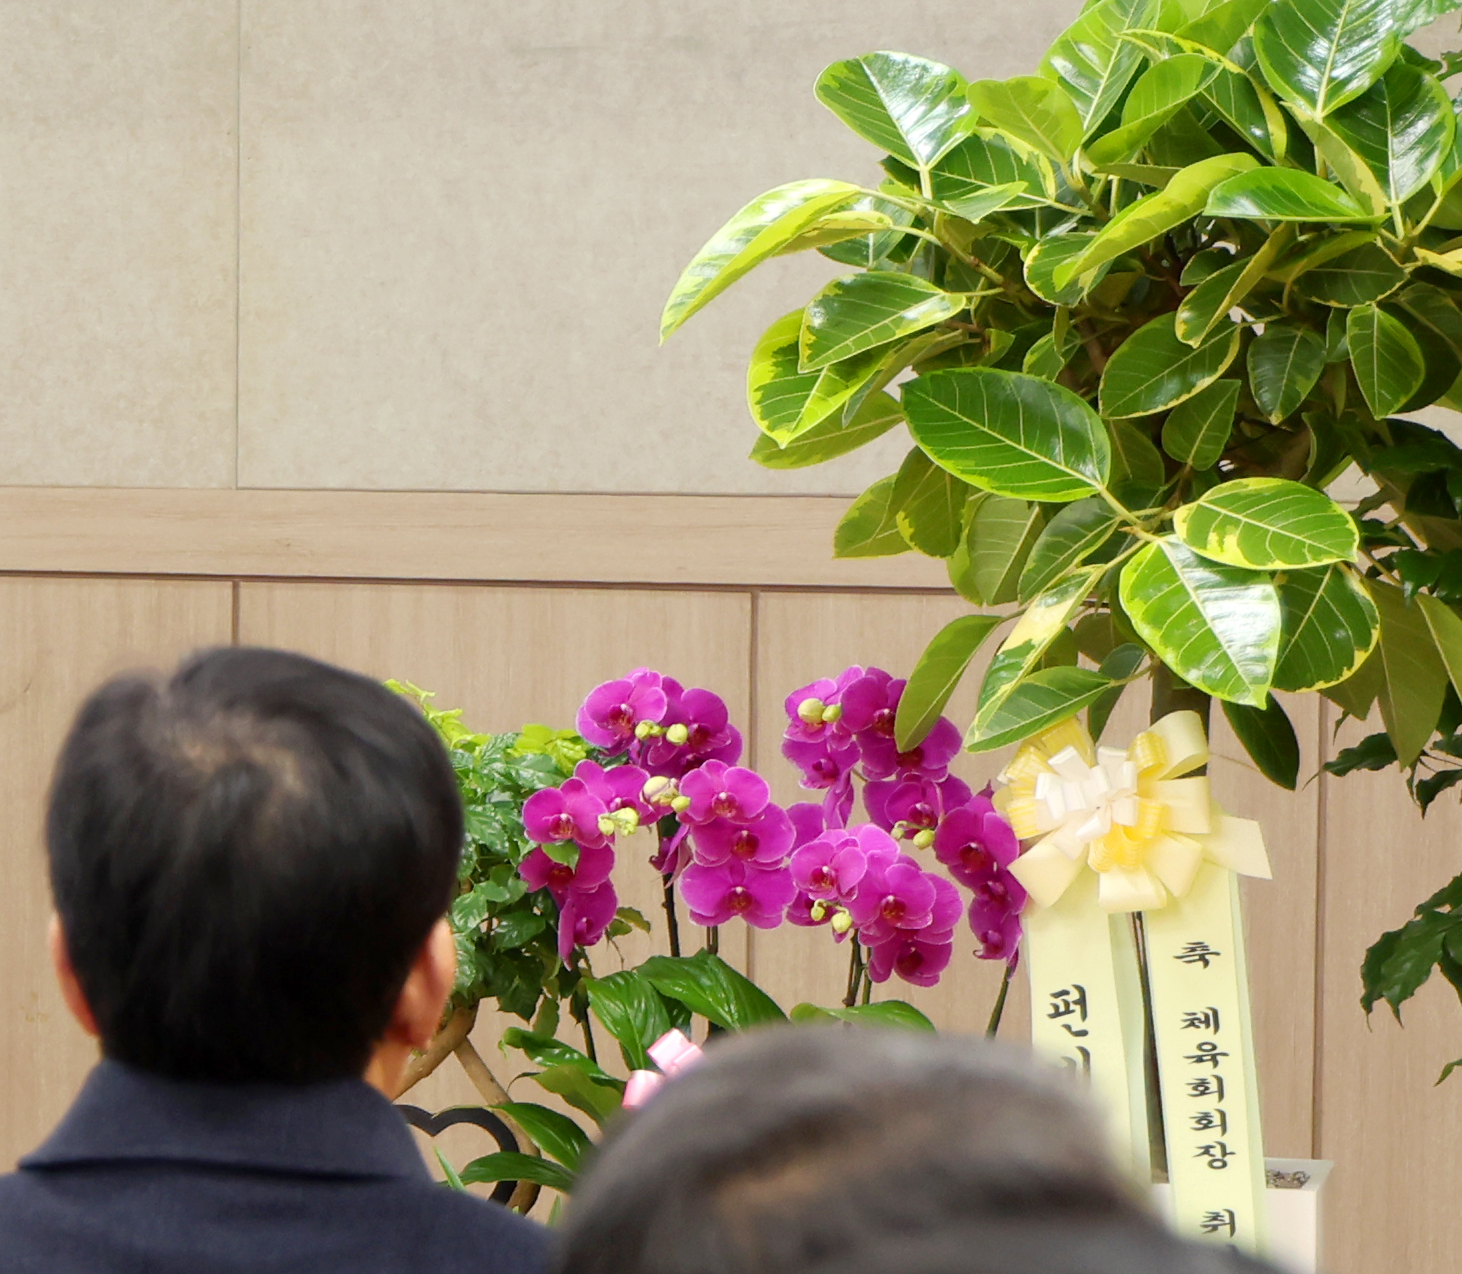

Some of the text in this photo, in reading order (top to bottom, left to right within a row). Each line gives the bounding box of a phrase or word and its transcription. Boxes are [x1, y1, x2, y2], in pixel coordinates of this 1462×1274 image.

[1173, 940, 1239, 1247] 축 체육회회장 취
